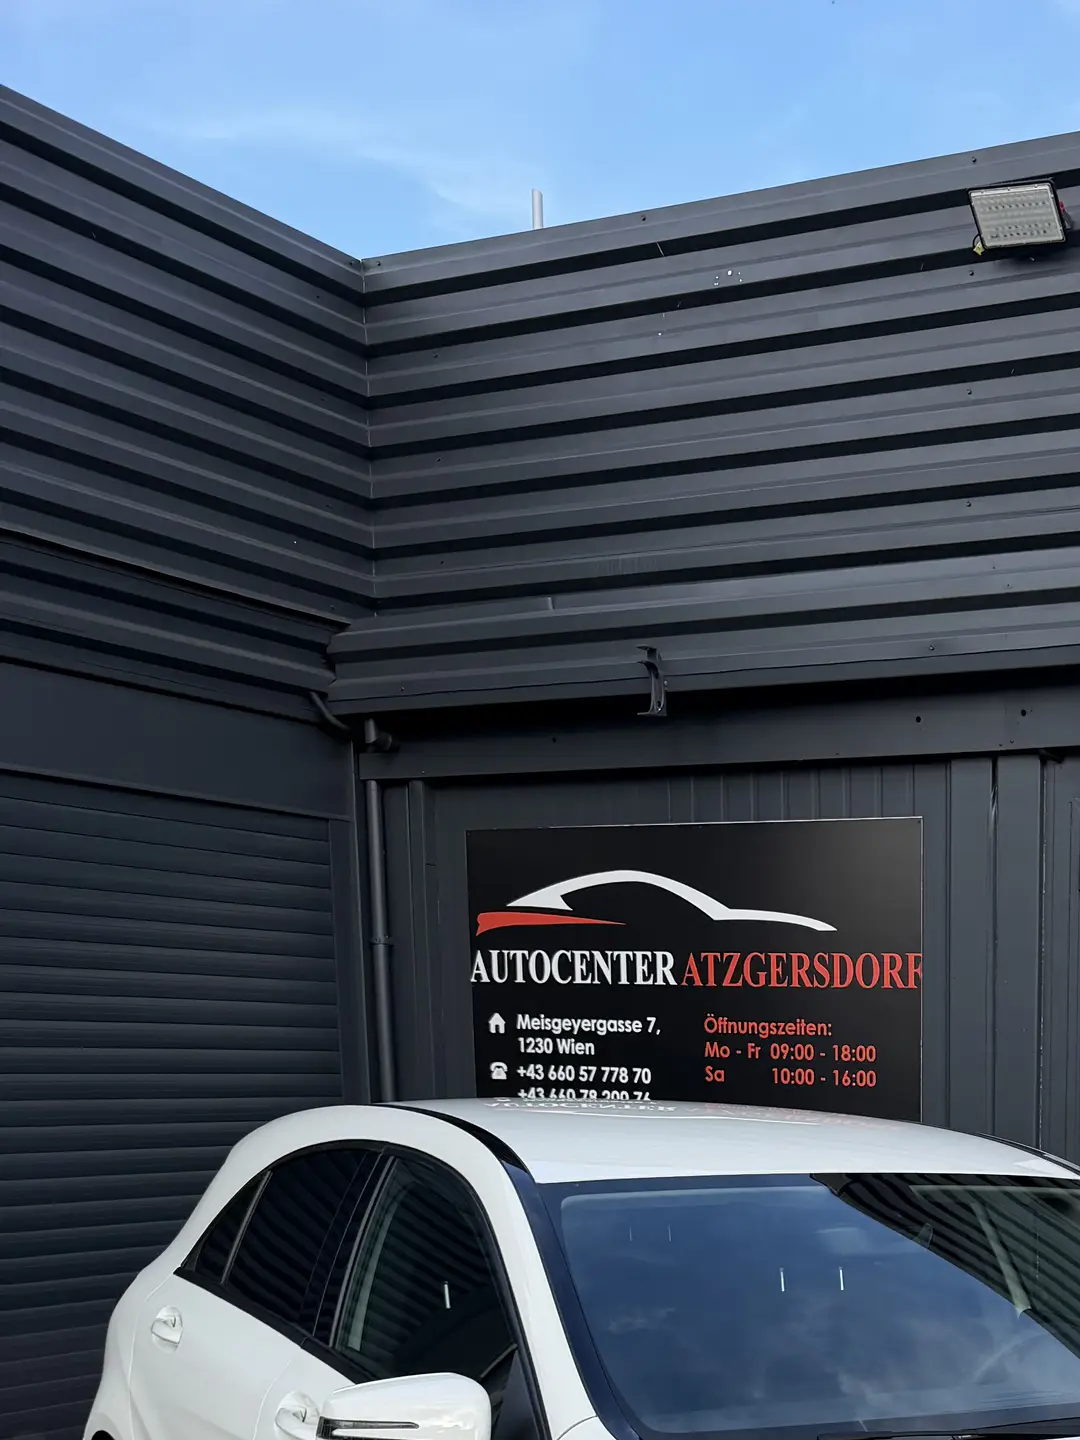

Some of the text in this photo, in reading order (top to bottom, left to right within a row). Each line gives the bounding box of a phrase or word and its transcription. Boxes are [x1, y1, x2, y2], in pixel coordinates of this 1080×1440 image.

[470, 949, 923, 989] AUTOCENTER ATZGERSDORF
[516, 1013, 661, 1035] Meisgeyergasse 7,
[703, 1013, 832, 1038] Öffnungszeiten:
[518, 1037, 595, 1055] 1230 Wien
[704, 1041, 730, 1059] Mo
[747, 1043, 761, 1059] Fr
[769, 1043, 814, 1061] 09:00
[832, 1045, 877, 1063] 18:00
[516, 1064, 651, 1084] +43 660 57 778 70
[704, 1066, 725, 1082] Sa
[771, 1068, 815, 1085] 10:00
[832, 1069, 877, 1087] 16:00
